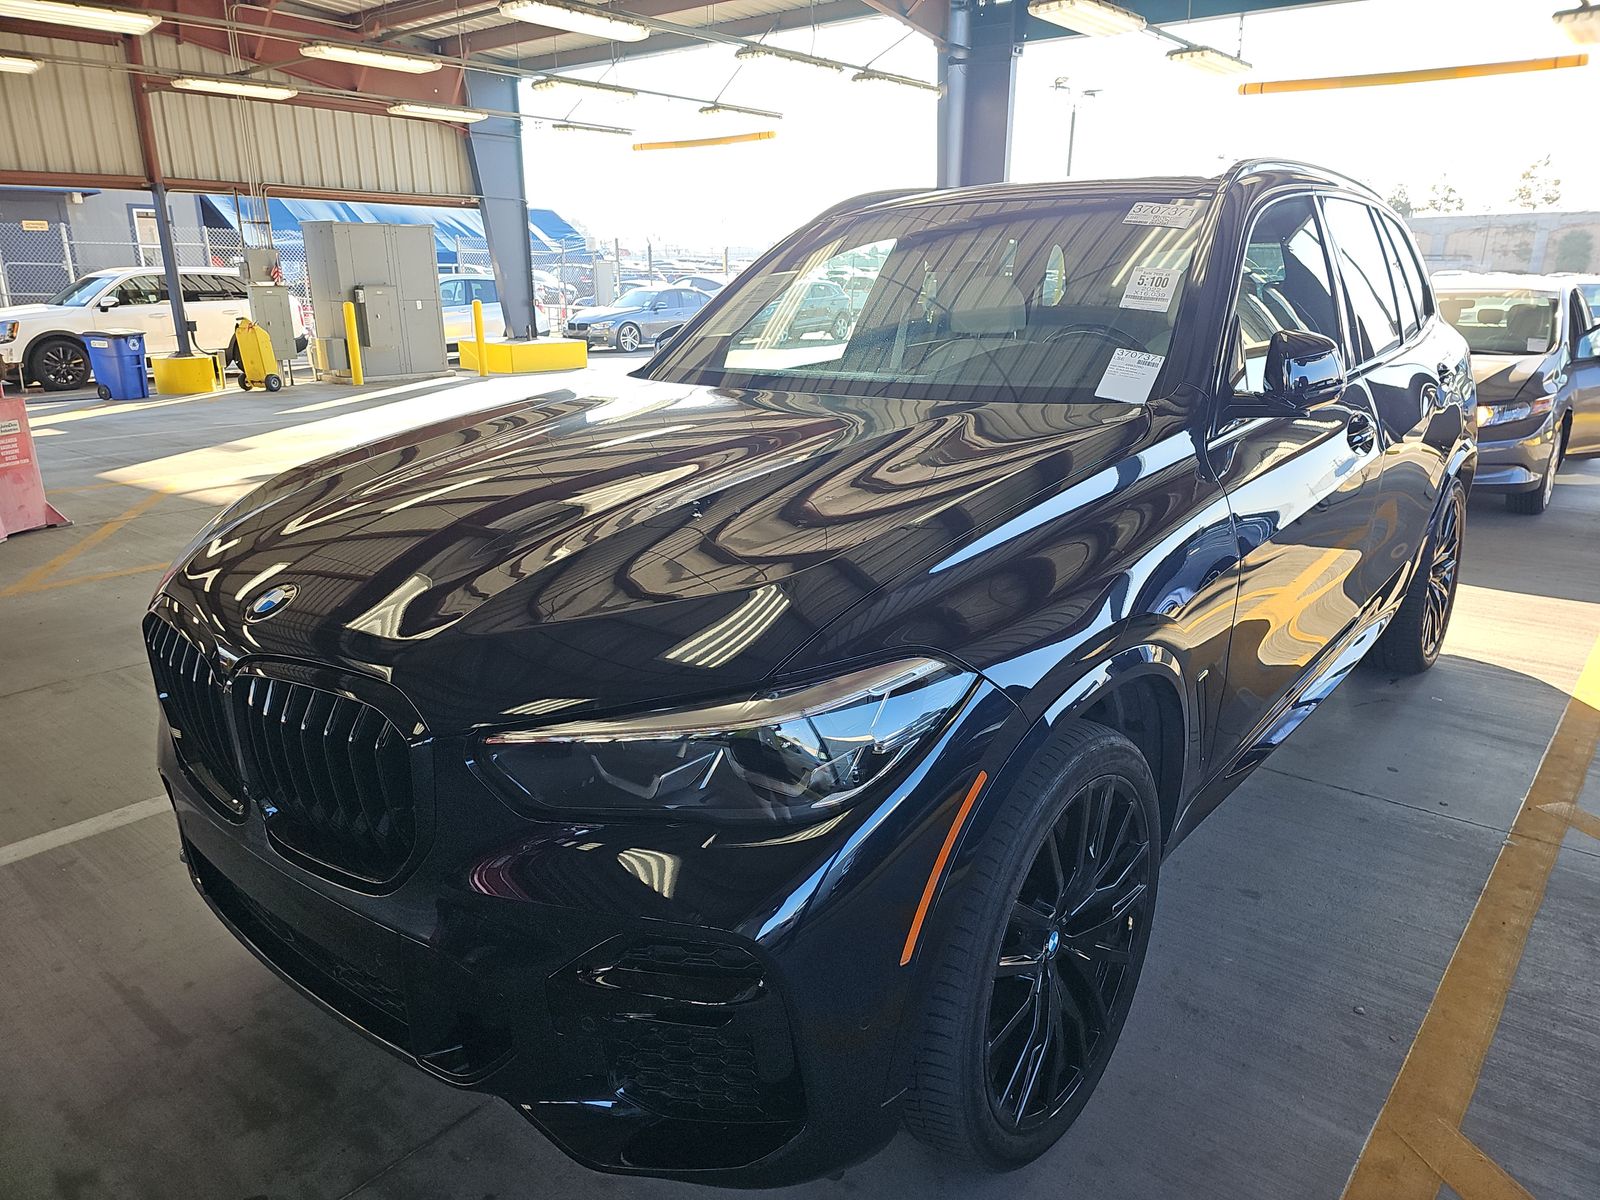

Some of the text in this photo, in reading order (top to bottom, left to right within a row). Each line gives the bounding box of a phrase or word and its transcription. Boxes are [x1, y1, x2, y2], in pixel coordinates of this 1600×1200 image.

[1133, 204, 1195, 217] 3707371
[1137, 275, 1169, 288] 5:100
[1117, 350, 1162, 363] 3707371
